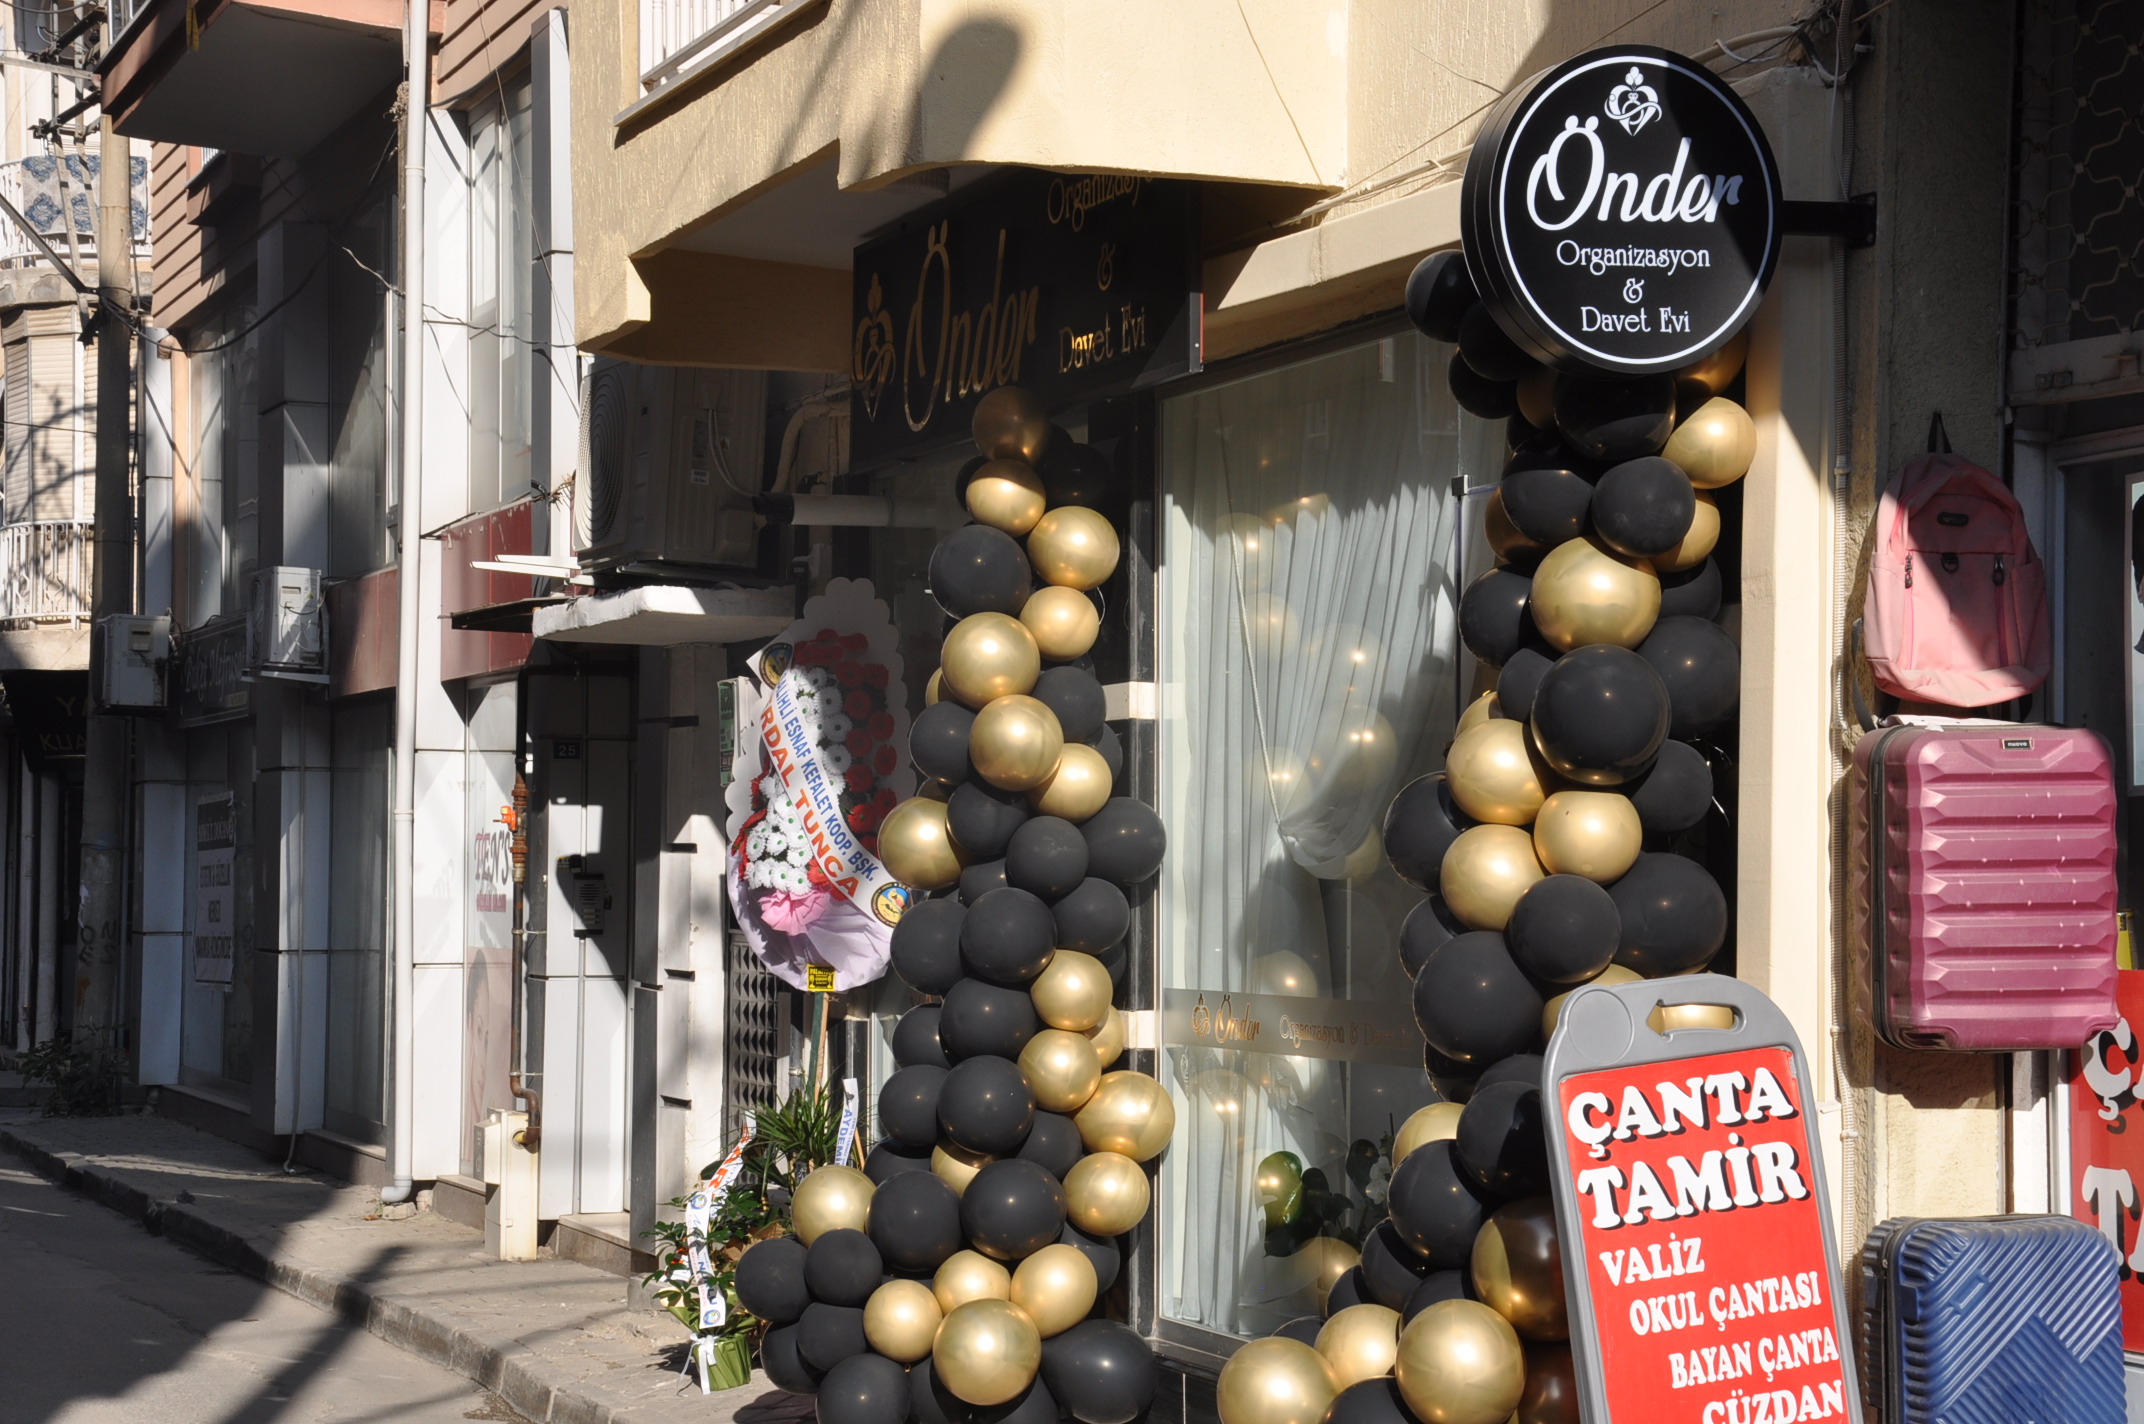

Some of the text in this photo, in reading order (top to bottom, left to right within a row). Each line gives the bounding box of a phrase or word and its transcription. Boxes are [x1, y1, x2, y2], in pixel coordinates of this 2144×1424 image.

[1526, 114, 1744, 231] Önder
[1096, 240, 1117, 291] &
[1556, 239, 1711, 276] Organizasyon
[1580, 306, 1691, 333] Davet Evi
[1622, 277, 1645, 304] &
[903, 218, 1040, 432] Önder
[1058, 301, 1146, 375] Davet Evi
[558, 744, 577, 757] 25
[760, 703, 796, 788] RDAL
[794, 788, 860, 899] TUNCA
[784, 716, 812, 759] ESNAF
[800, 757, 834, 816] KEFALET
[824, 812, 853, 856] KOOP.
[847, 850, 880, 882] BŞK.
[1214, 993, 1262, 1044] Önder
[1279, 1013, 1345, 1049] Organizasyon
[1567, 1066, 1797, 1158] ÇANTA
[1577, 1132, 1809, 1230] TAMİR
[1598, 1231, 1706, 1287] VALİZ
[1629, 1270, 1822, 1336] OKUL ÇANTASI
[1667, 1326, 1840, 1389] BAYAN ÇANTA
[1702, 1379, 1844, 1424] CÜZDAN
